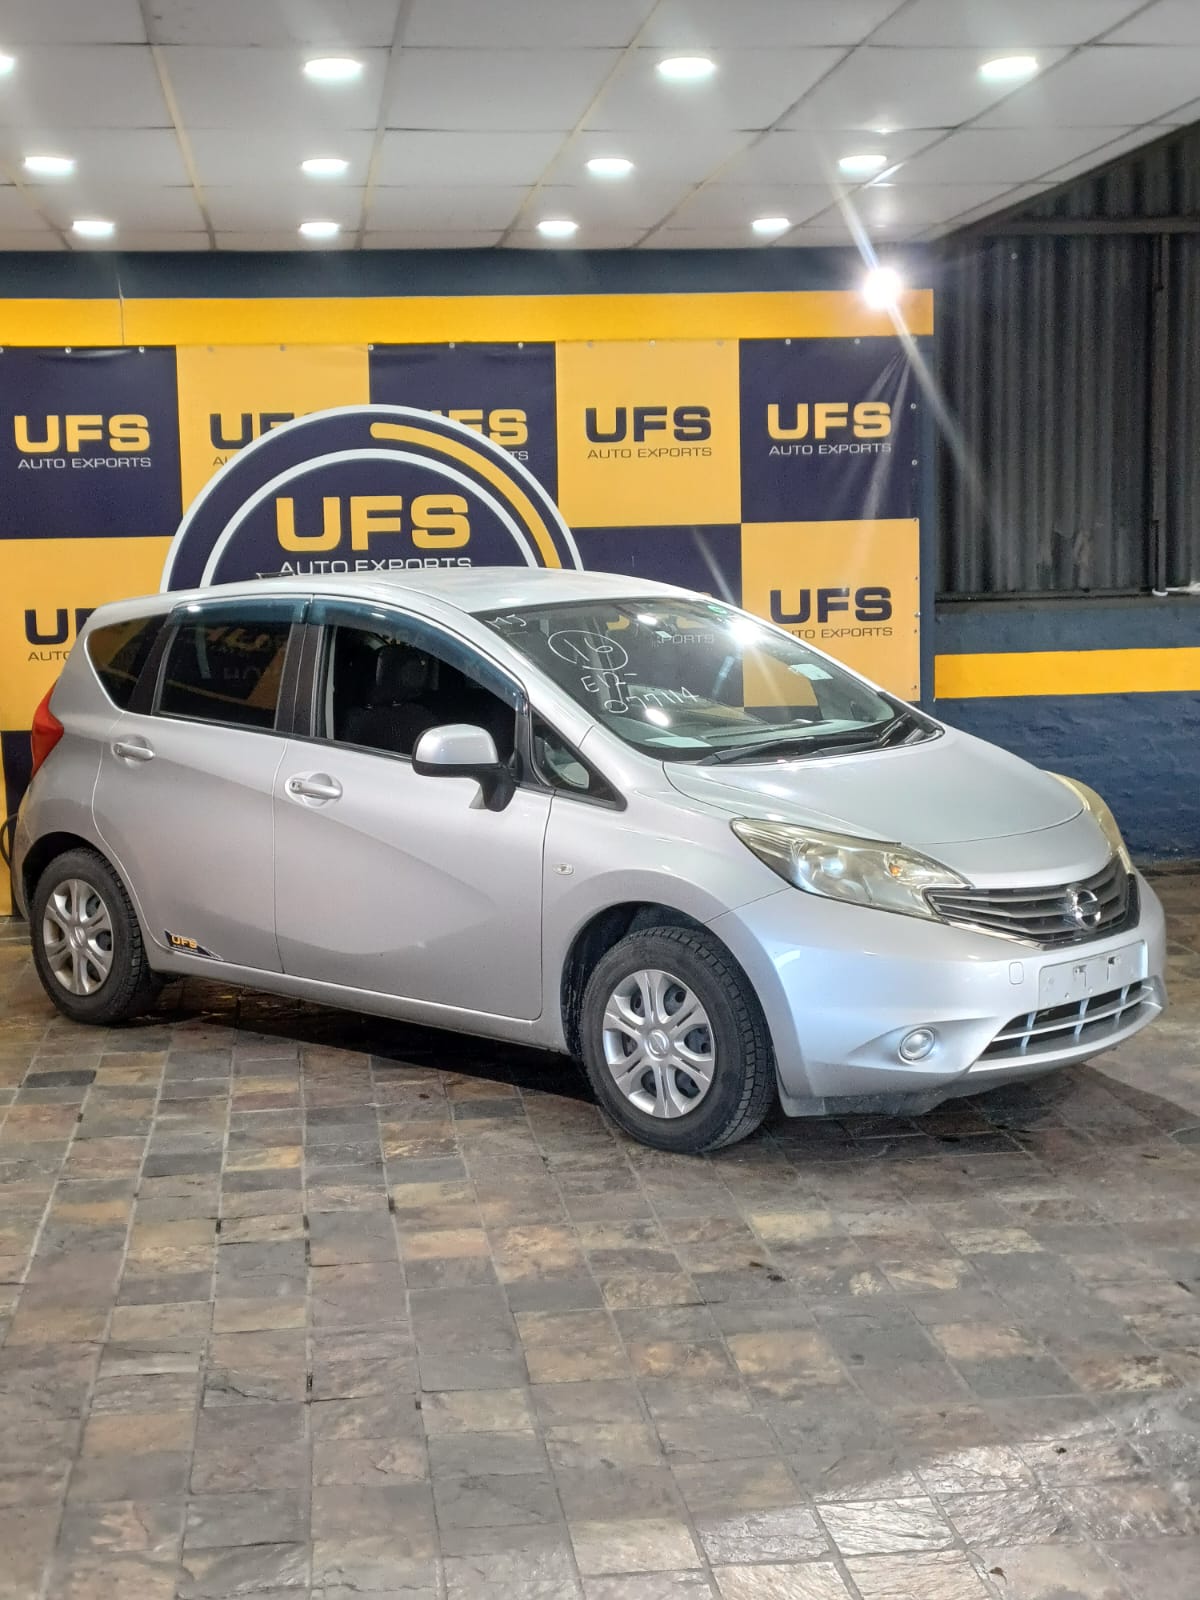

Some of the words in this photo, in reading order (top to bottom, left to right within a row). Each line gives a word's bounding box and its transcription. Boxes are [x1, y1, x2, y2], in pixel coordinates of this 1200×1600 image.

[585, 406, 711, 443] UFS
[767, 402, 891, 439] UFS
[14, 414, 150, 453] UFS
[587, 449, 632, 459] AUTO
[637, 447, 712, 458] EXPORTS
[769, 445, 813, 456] AUTO
[818, 443, 892, 454] EXPORTS
[18, 458, 66, 469] AUTO
[72, 457, 151, 468] EXPORTS
[276, 494, 470, 551] UFS
[280, 561, 348, 575] AUTO
[355, 557, 471, 572] EXPORTS
[770, 587, 892, 624] UFS
[821, 627, 893, 638] EXPORTS
[171, 935, 198, 948] UFS
